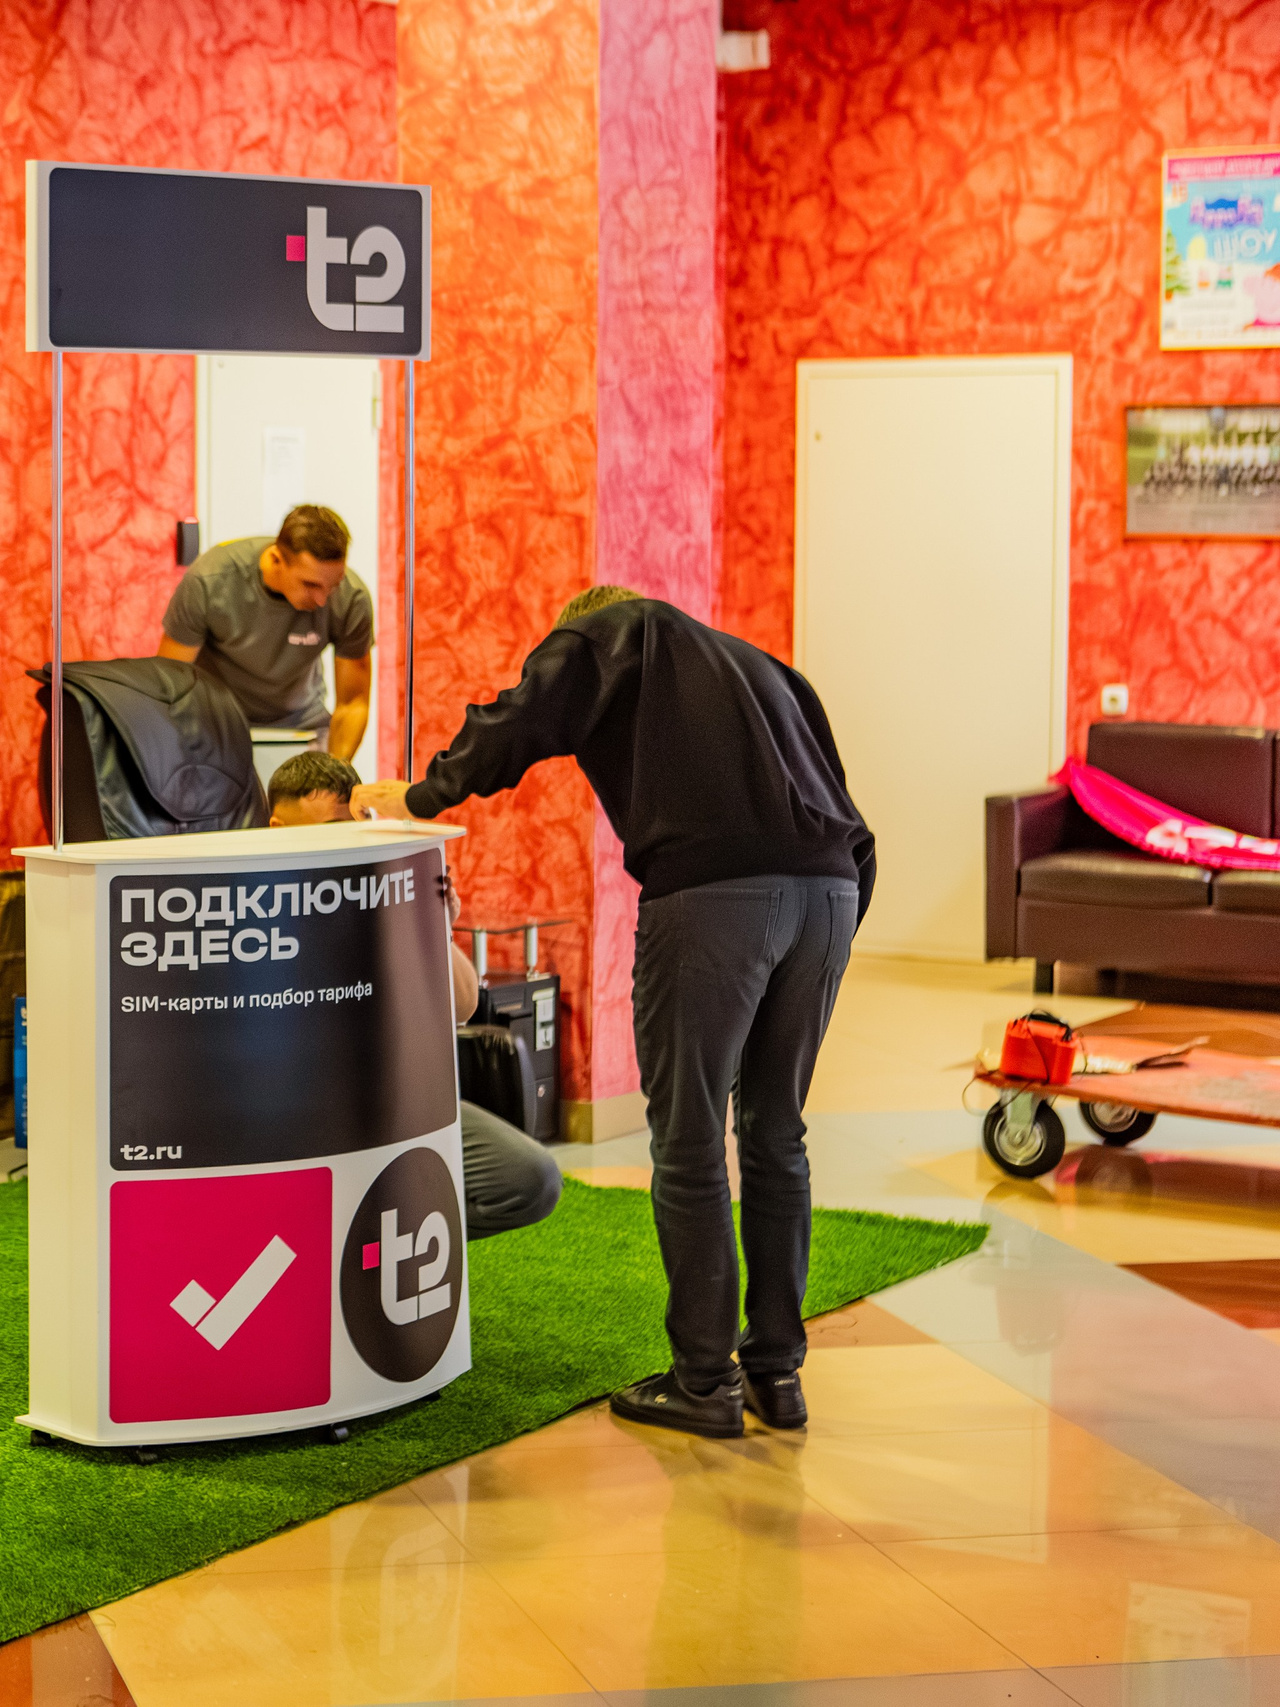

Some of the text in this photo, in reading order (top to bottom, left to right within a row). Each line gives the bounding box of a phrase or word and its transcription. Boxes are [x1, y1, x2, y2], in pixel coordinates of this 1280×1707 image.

[286, 206, 406, 333] t2
[120, 868, 415, 927] ПОДКЛЮЧИТЕ
[120, 928, 300, 972] ЗДЕСЬ
[120, 980, 373, 1015] SIM-карты и подбор тарифа
[120, 1144, 183, 1161] t2.ru
[362, 1208, 451, 1326] t2
